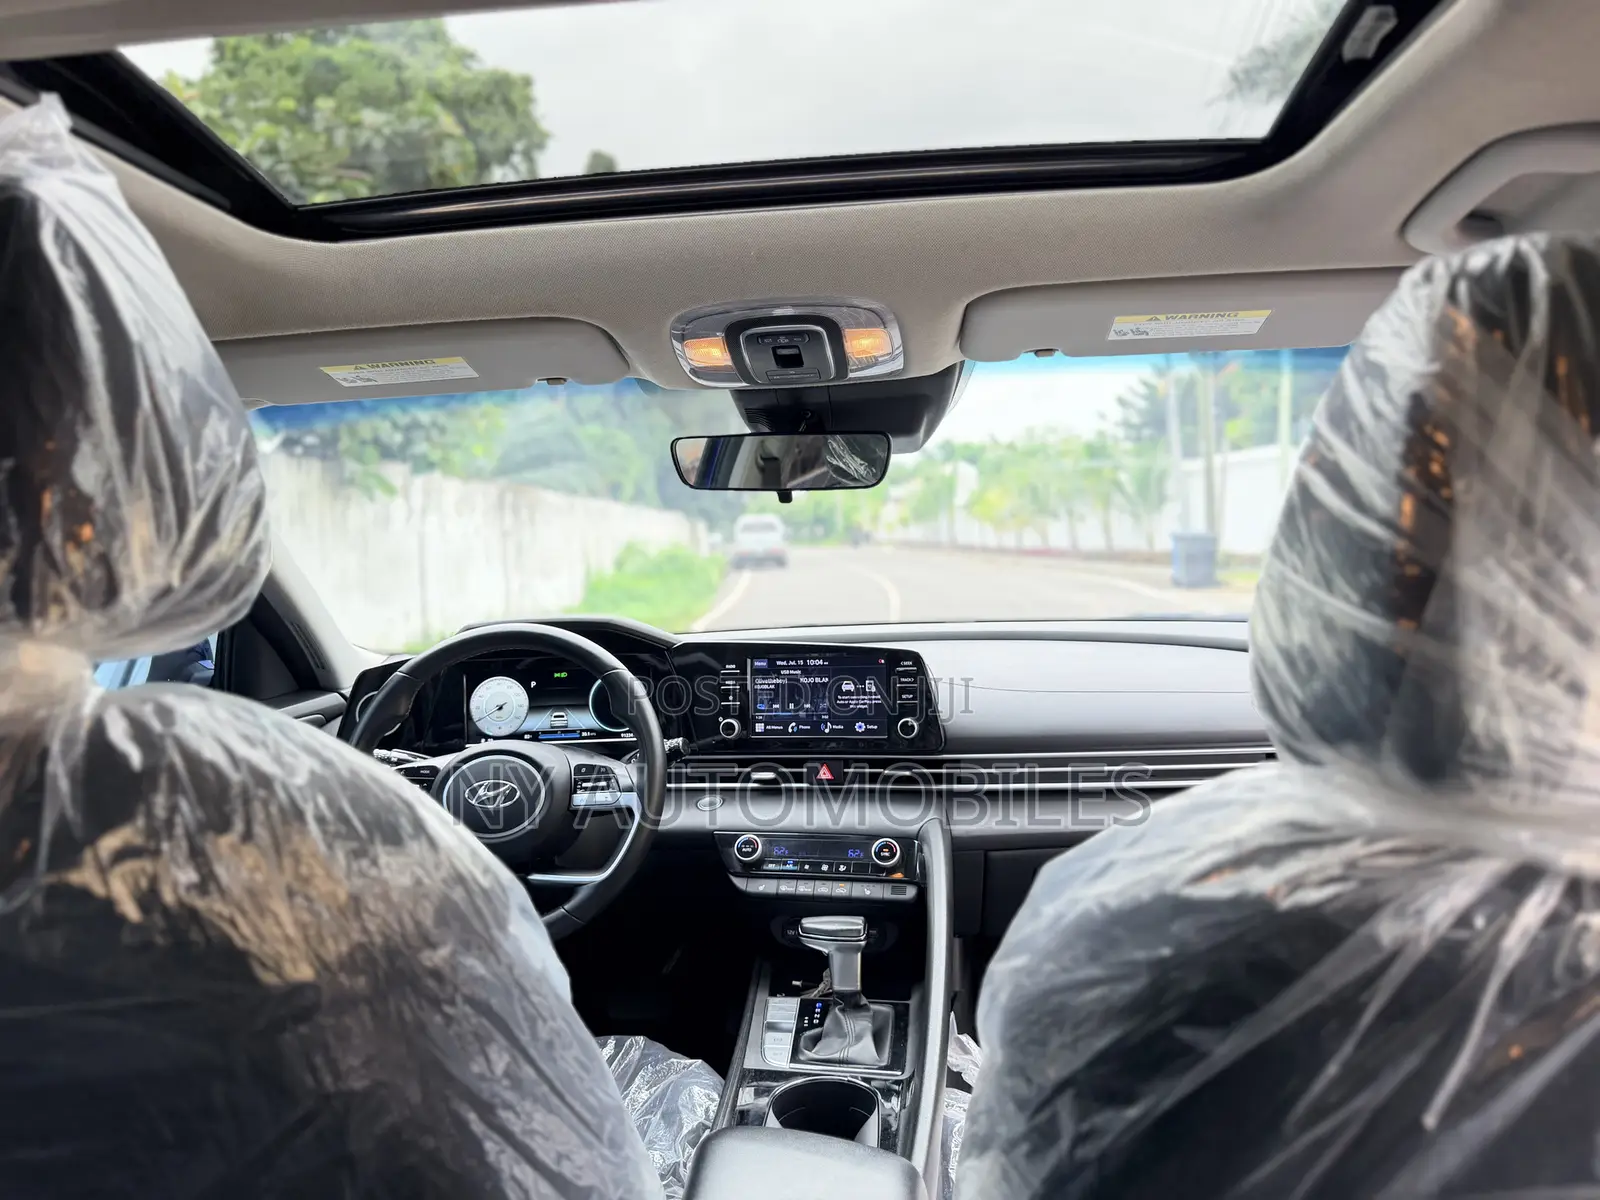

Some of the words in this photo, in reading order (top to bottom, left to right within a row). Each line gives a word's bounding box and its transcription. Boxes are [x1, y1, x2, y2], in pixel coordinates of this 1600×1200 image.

[1165, 312, 1239, 320] WARNING
[366, 359, 435, 369] WARNING
[530, 681, 536, 689] P
